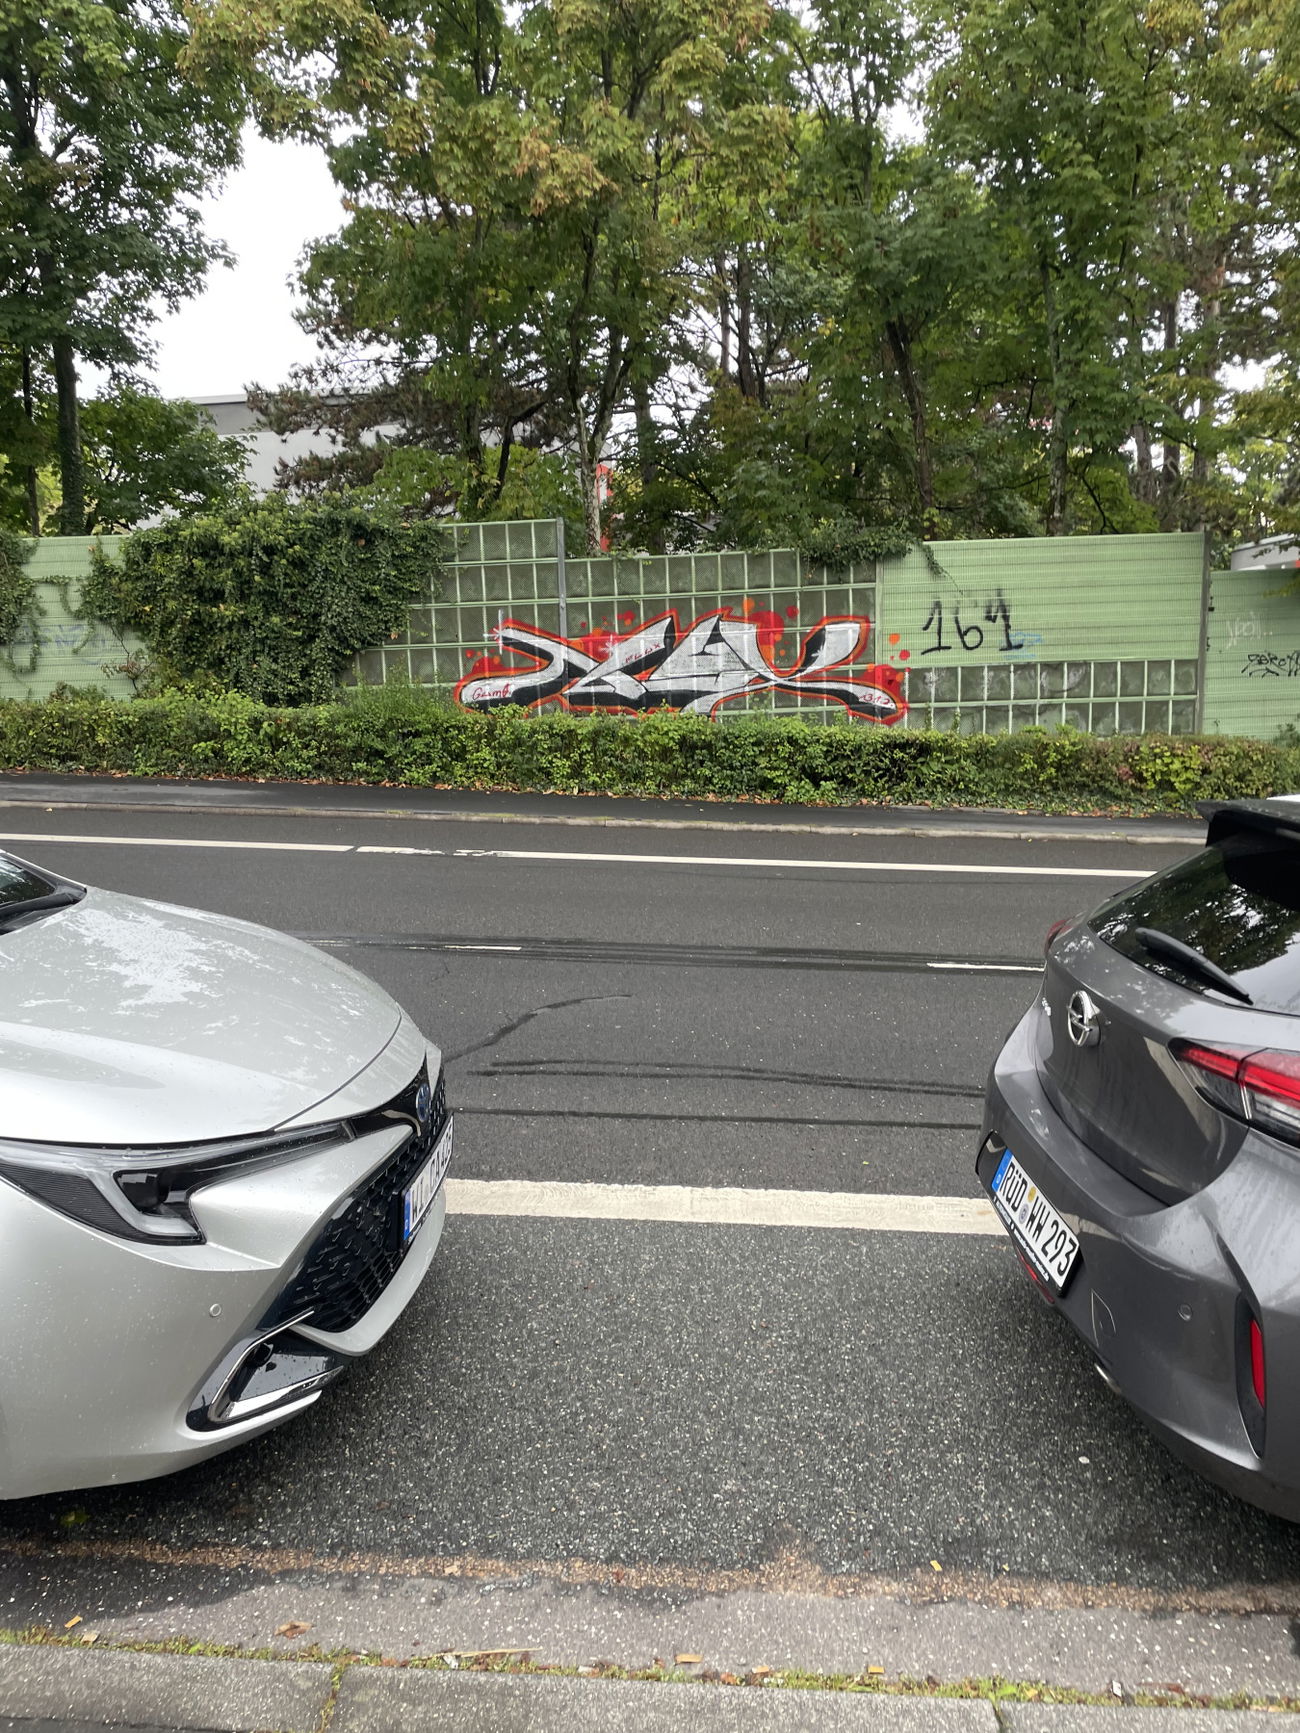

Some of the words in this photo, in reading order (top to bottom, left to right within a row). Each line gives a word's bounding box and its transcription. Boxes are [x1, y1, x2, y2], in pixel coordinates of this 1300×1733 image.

[1000, 1162, 1028, 1213] RÜD
[1025, 1196, 1051, 1244] WW
[1041, 1219, 1077, 1277] 293
